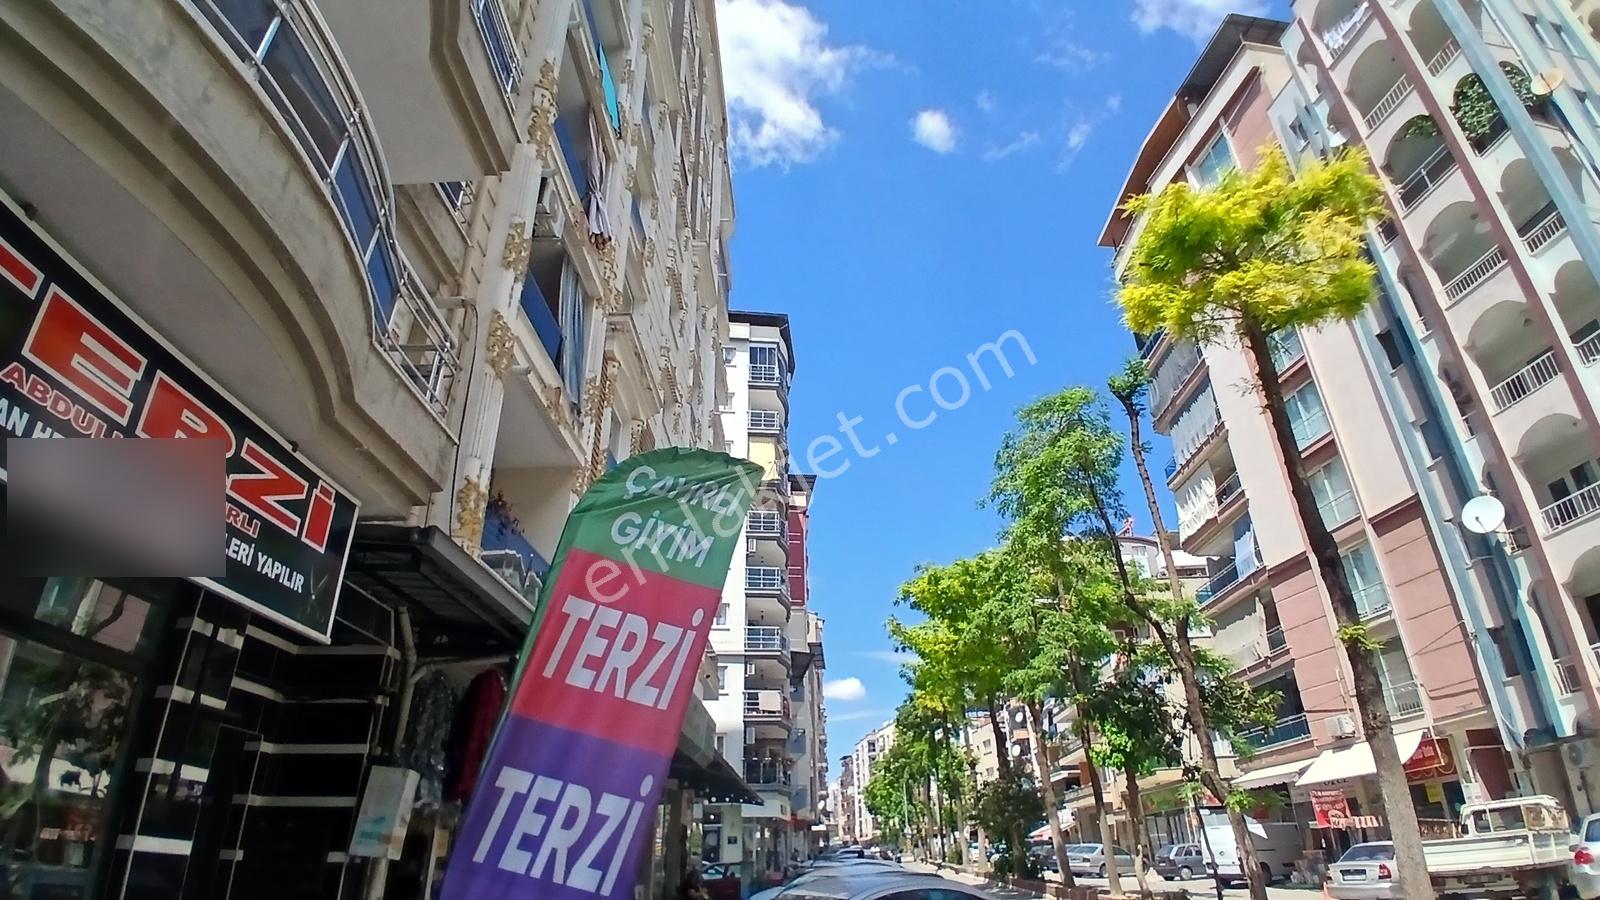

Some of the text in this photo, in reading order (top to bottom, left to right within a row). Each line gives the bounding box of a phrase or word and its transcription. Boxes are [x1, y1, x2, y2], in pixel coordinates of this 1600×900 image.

[0, 236, 335, 553] ERZİ
[226, 501, 260, 538] RLI
[610, 510, 715, 568] GİYİM
[256, 551, 305, 594] YAPILIR
[541, 594, 705, 711] TERZİ
[472, 765, 655, 897] TERZİ
